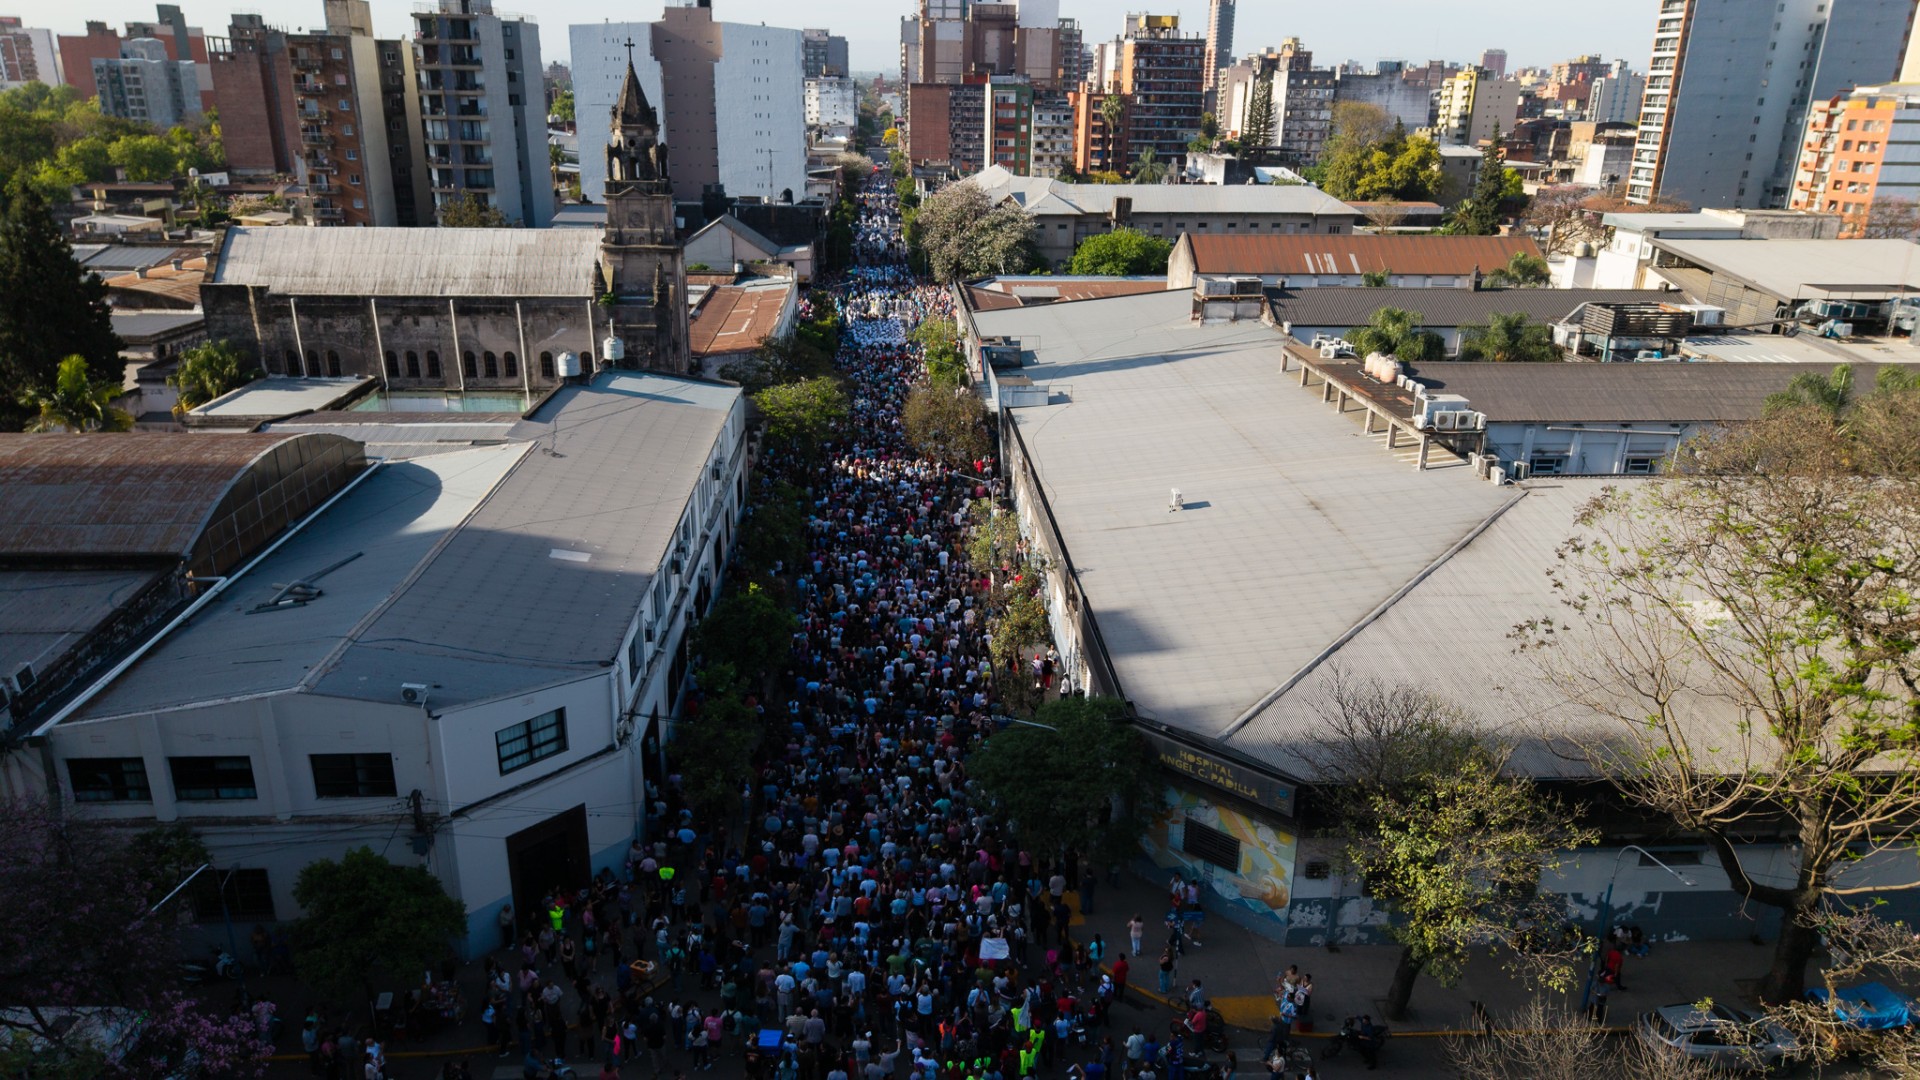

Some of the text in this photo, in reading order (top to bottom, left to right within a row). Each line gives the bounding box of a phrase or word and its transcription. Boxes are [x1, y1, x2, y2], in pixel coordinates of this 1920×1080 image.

[1159, 753, 1258, 799] ANGEL C. PADILLA
[1179, 750, 1233, 778] HOSPITAL
